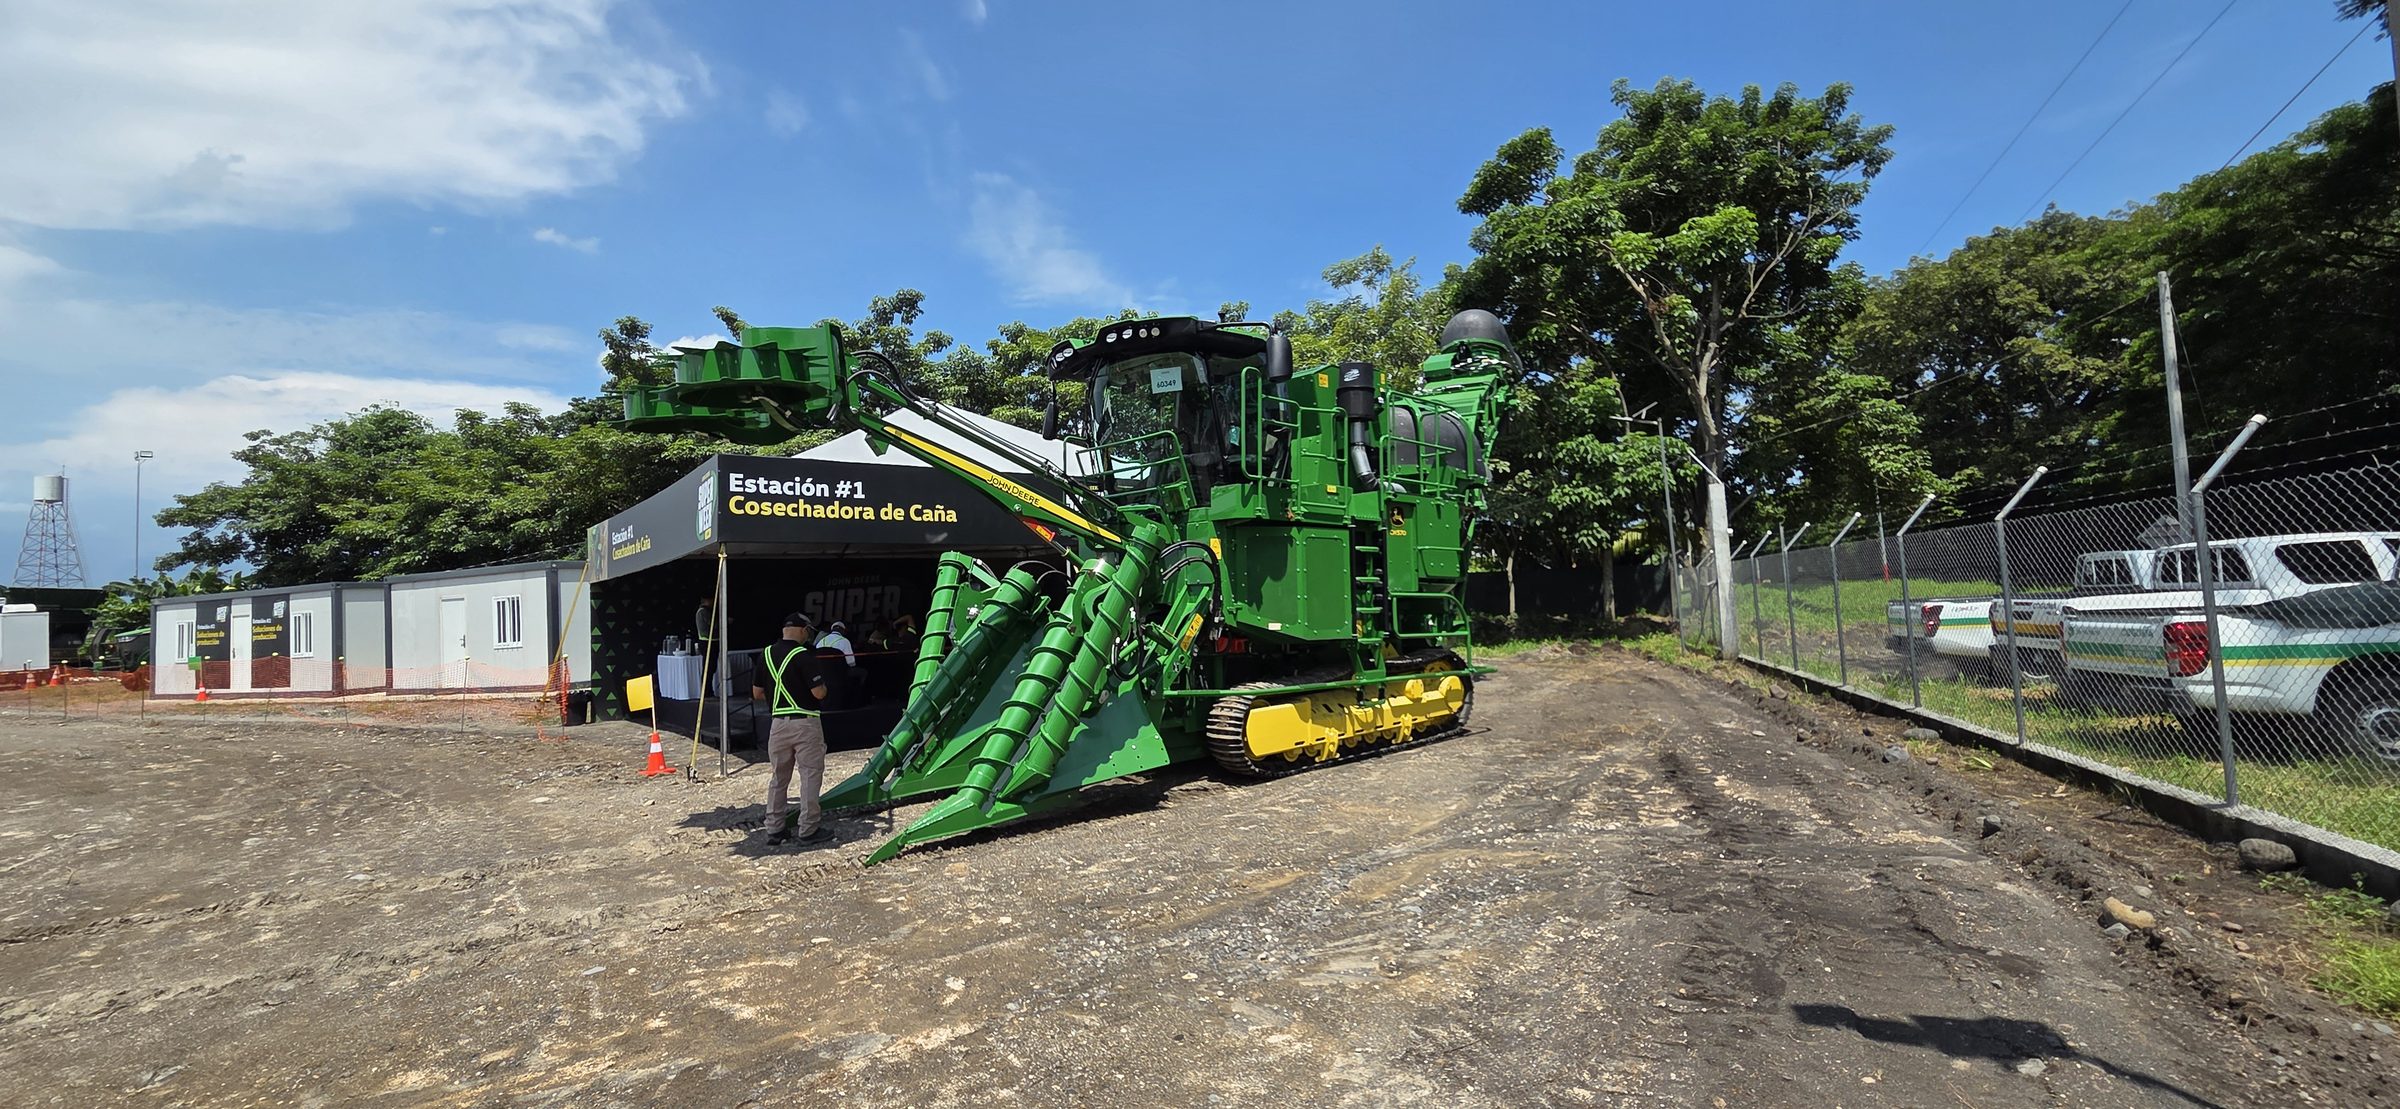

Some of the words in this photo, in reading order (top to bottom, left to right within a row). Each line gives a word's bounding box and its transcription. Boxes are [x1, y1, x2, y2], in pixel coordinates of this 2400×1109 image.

[729, 473, 829, 497] Estación
[834, 480, 865, 499] #1
[987, 475, 1012, 493] JOHN
[1011, 485, 1041, 506] DEERE
[729, 496, 875, 520] Cosechadora
[880, 503, 905, 521] de
[909, 504, 958, 523] Caña
[805, 584, 902, 627] SUPER
